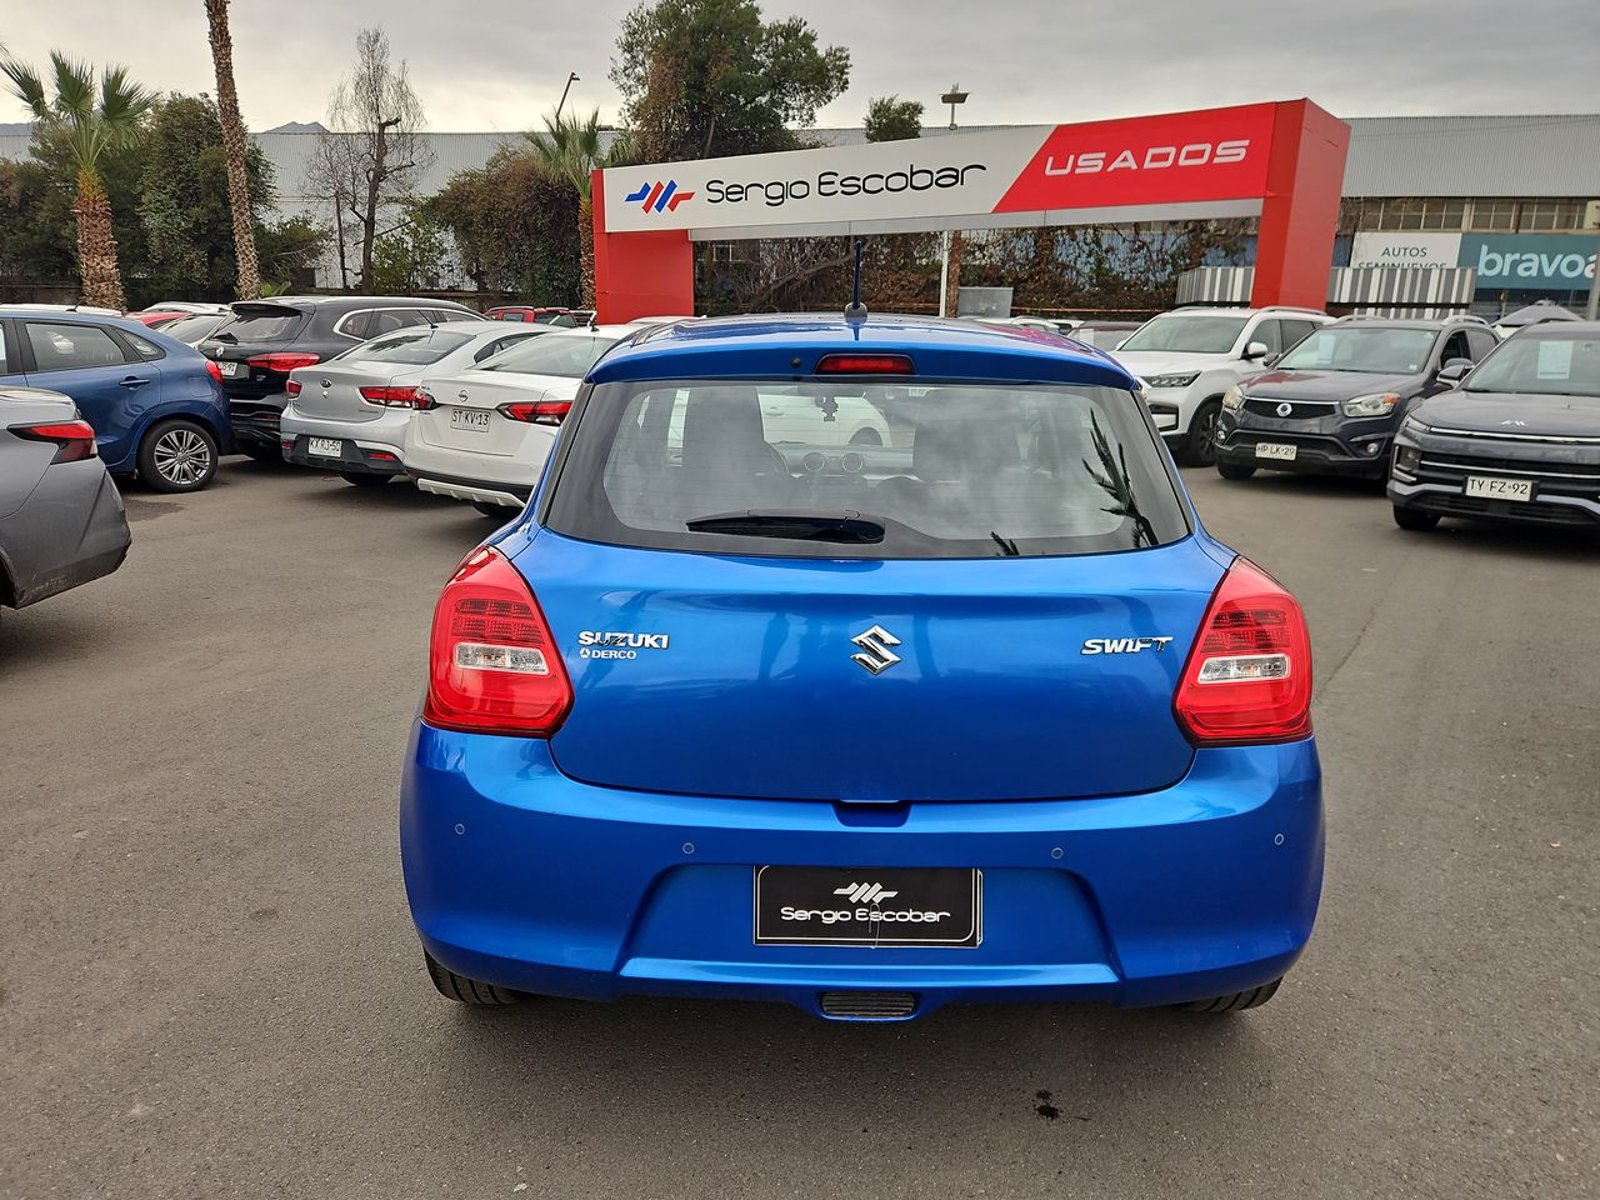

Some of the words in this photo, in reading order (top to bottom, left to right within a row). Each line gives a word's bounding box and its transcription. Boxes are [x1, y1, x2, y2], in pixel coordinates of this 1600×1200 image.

[1044, 139, 1250, 176] USADOS
[706, 180, 810, 206] Sergio
[818, 164, 986, 197] Escobar
[1381, 246, 1428, 257] AUTOS
[578, 631, 669, 649] SUZUKI
[1081, 636, 1174, 655] SWIFT
[591, 649, 637, 660] DERCO
[780, 907, 852, 924] Sergio
[855, 908, 951, 923] Escobar
